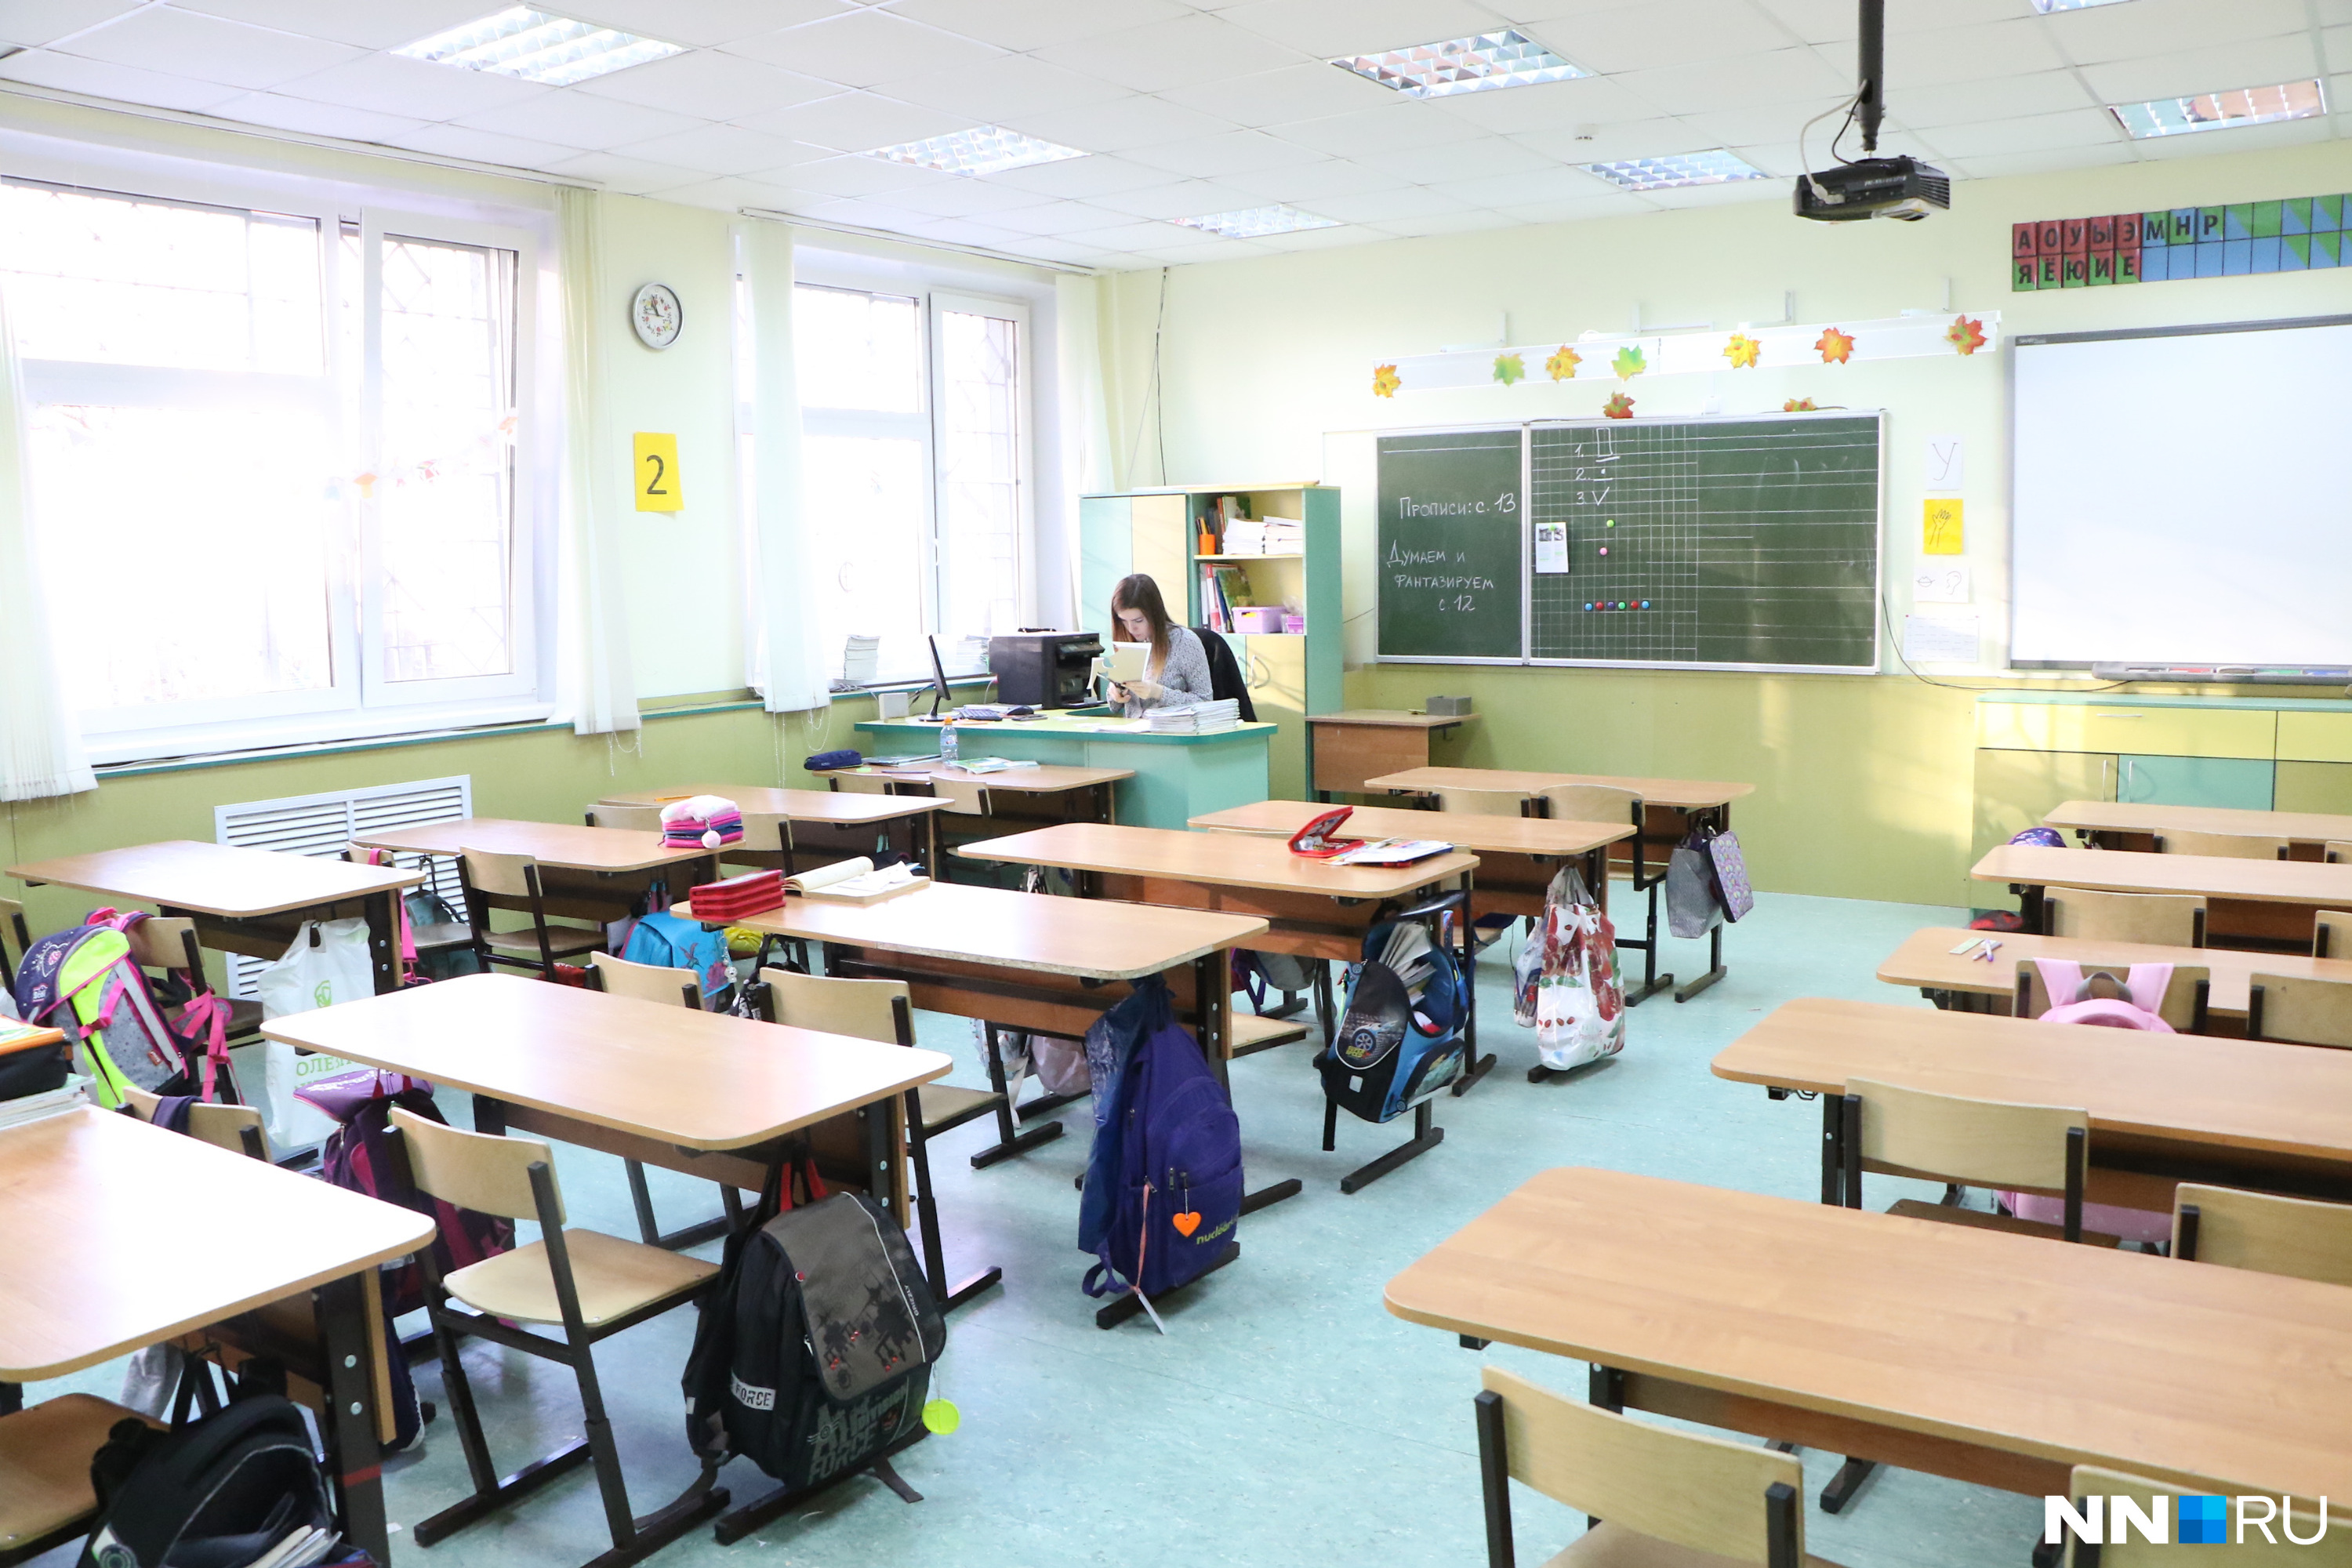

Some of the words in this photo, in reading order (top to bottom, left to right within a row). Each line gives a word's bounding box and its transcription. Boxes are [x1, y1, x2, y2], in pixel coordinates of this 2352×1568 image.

[2017, 230, 2032, 250] А
[2044, 227, 2058, 248] О
[2070, 226, 2082, 246] У
[2092, 223, 2112, 245] Ы
[2122, 221, 2136, 242] Э
[2146, 220, 2165, 241] М
[2176, 215, 2191, 237] Н
[2204, 214, 2219, 236] Р
[2018, 263, 2032, 285] Я
[2044, 258, 2056, 282] Ё
[2066, 259, 2085, 281] Ю
[2095, 257, 2111, 278] И
[2123, 256, 2135, 277] Е
[646, 454, 667, 495] 2
[1494, 492, 1517, 514] 13
[1454, 594, 1476, 612] 12
[735, 1382, 772, 1406] FORCE
